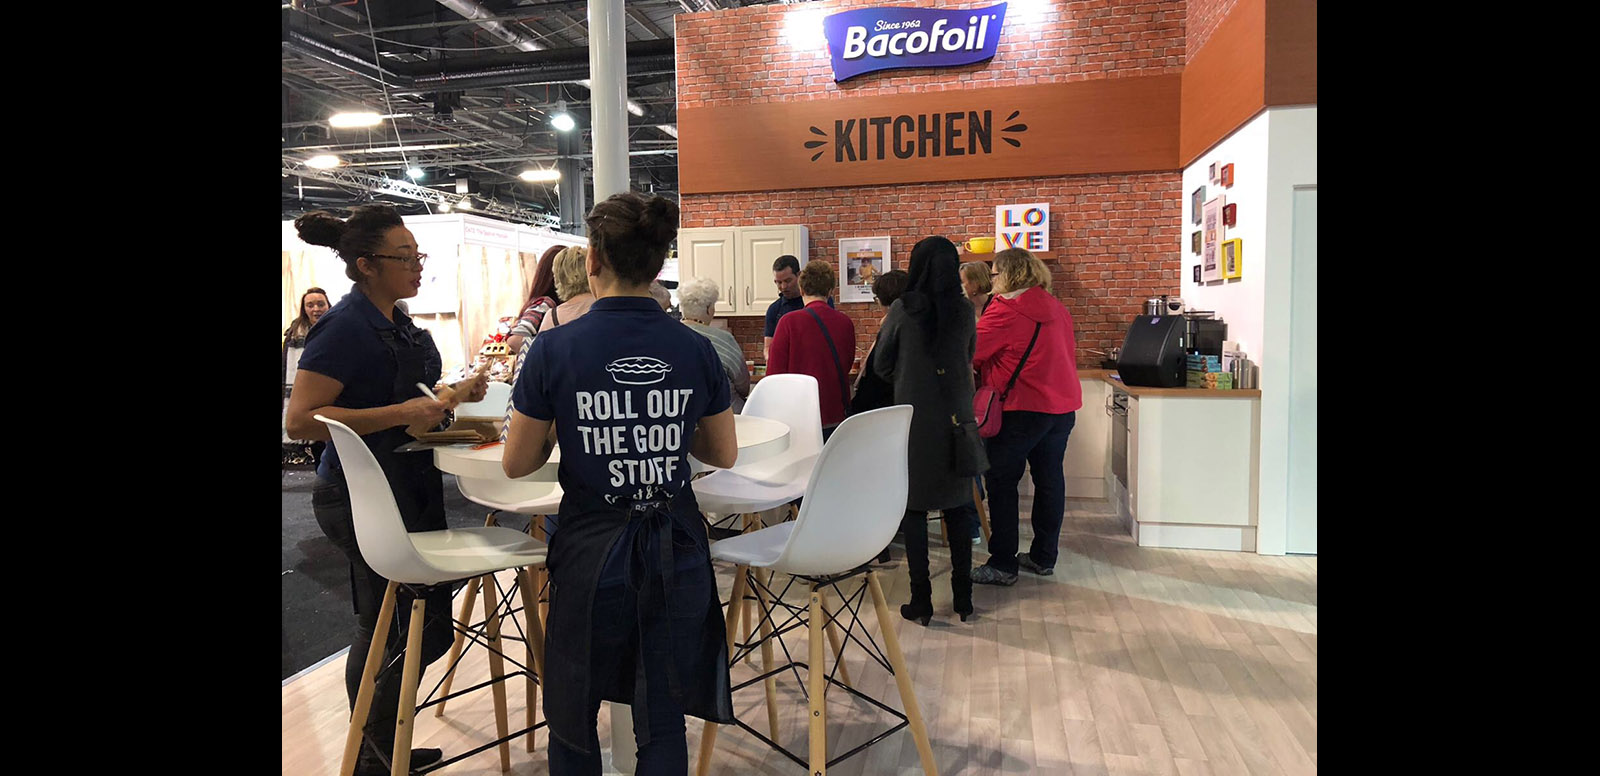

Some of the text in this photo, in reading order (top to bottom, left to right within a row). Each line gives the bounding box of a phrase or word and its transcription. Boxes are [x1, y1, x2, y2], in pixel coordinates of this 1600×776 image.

[843, 14, 990, 60] Bacofoil
[874, 20, 921, 32] Since 1962
[835, 110, 992, 162] KITCHEN
[1002, 208, 1046, 227] LO
[1001, 231, 1043, 249] VE
[576, 389, 693, 420] ROLL OUT
[577, 421, 684, 455] THE GOO
[608, 456, 679, 487] STUFF
